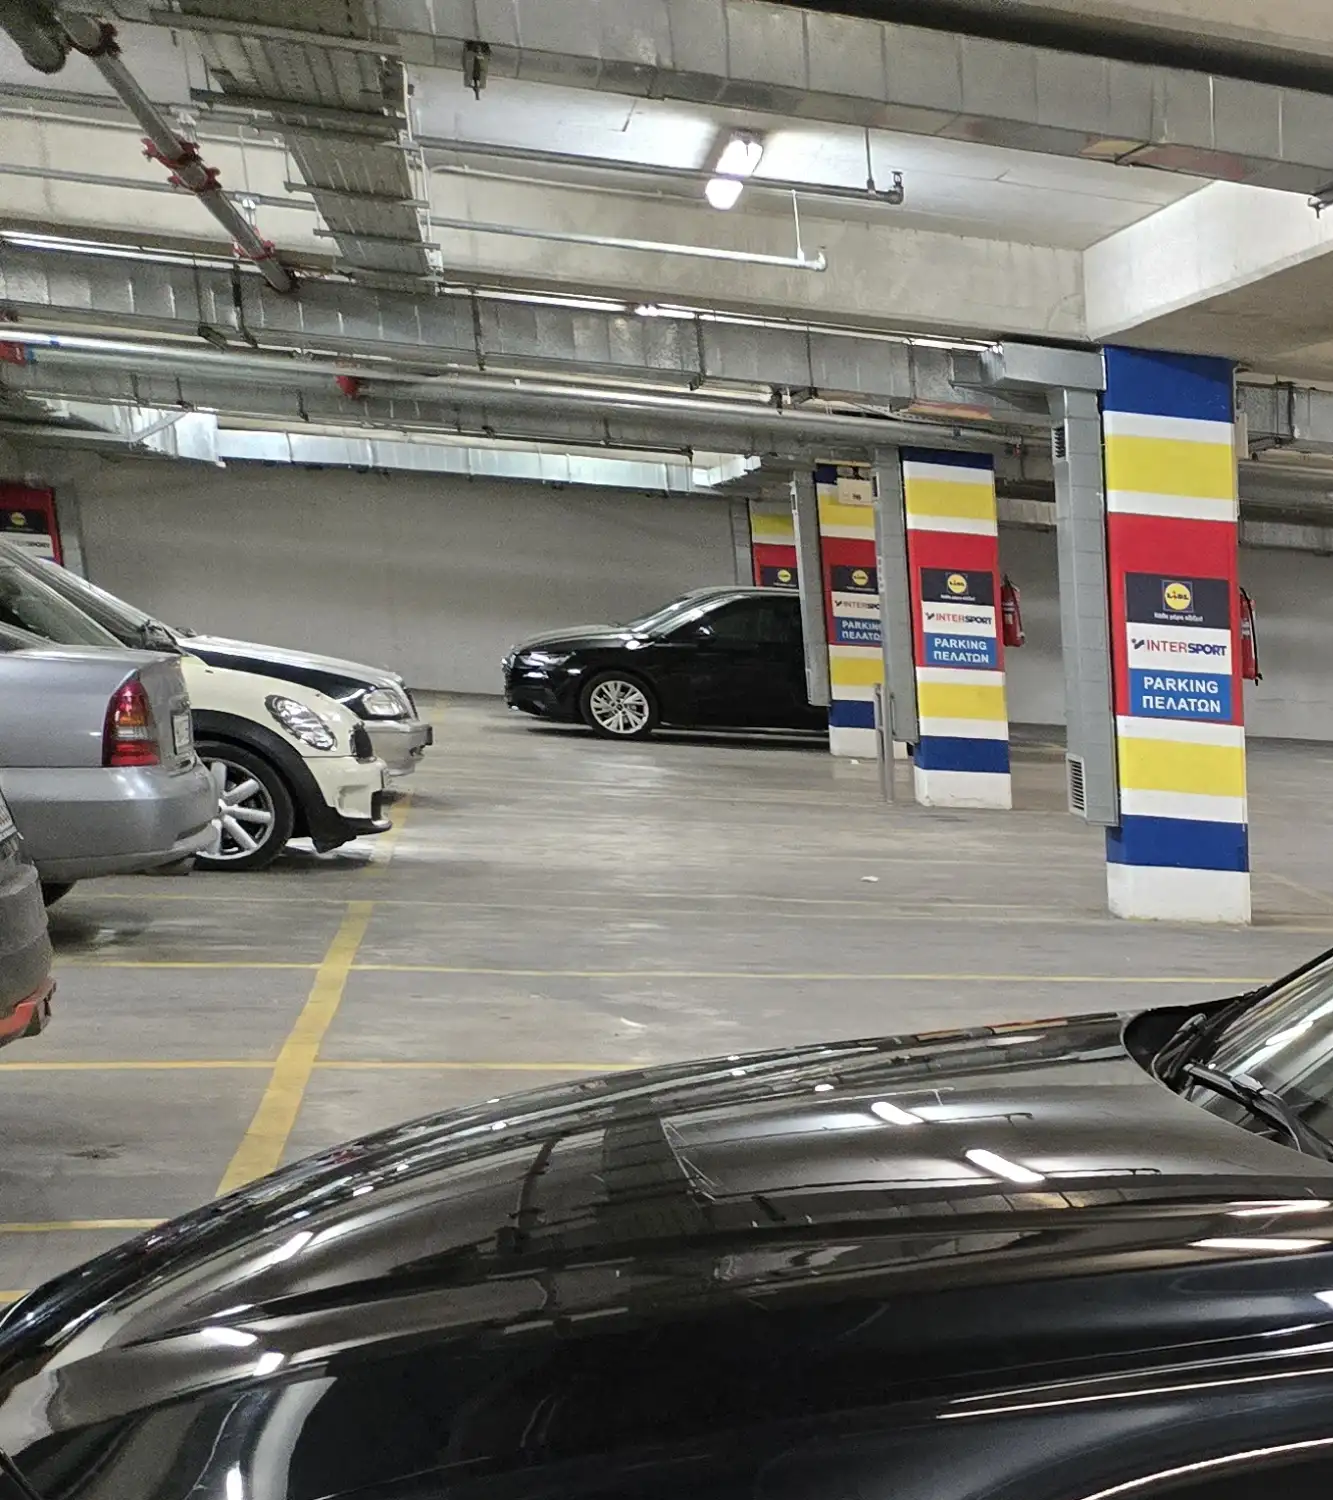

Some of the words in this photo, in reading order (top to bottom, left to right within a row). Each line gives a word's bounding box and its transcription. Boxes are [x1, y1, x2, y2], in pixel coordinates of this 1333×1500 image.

[936, 613, 992, 625] INTERSPORT
[934, 638, 987, 650] PARKING
[1147, 639, 1227, 656] INTERSPORT
[933, 651, 989, 663] ΠΕΛΑΤΩΝ
[1143, 676, 1219, 694] PARKING
[1142, 695, 1221, 713] ΠΕΛΑΤΩΝ
